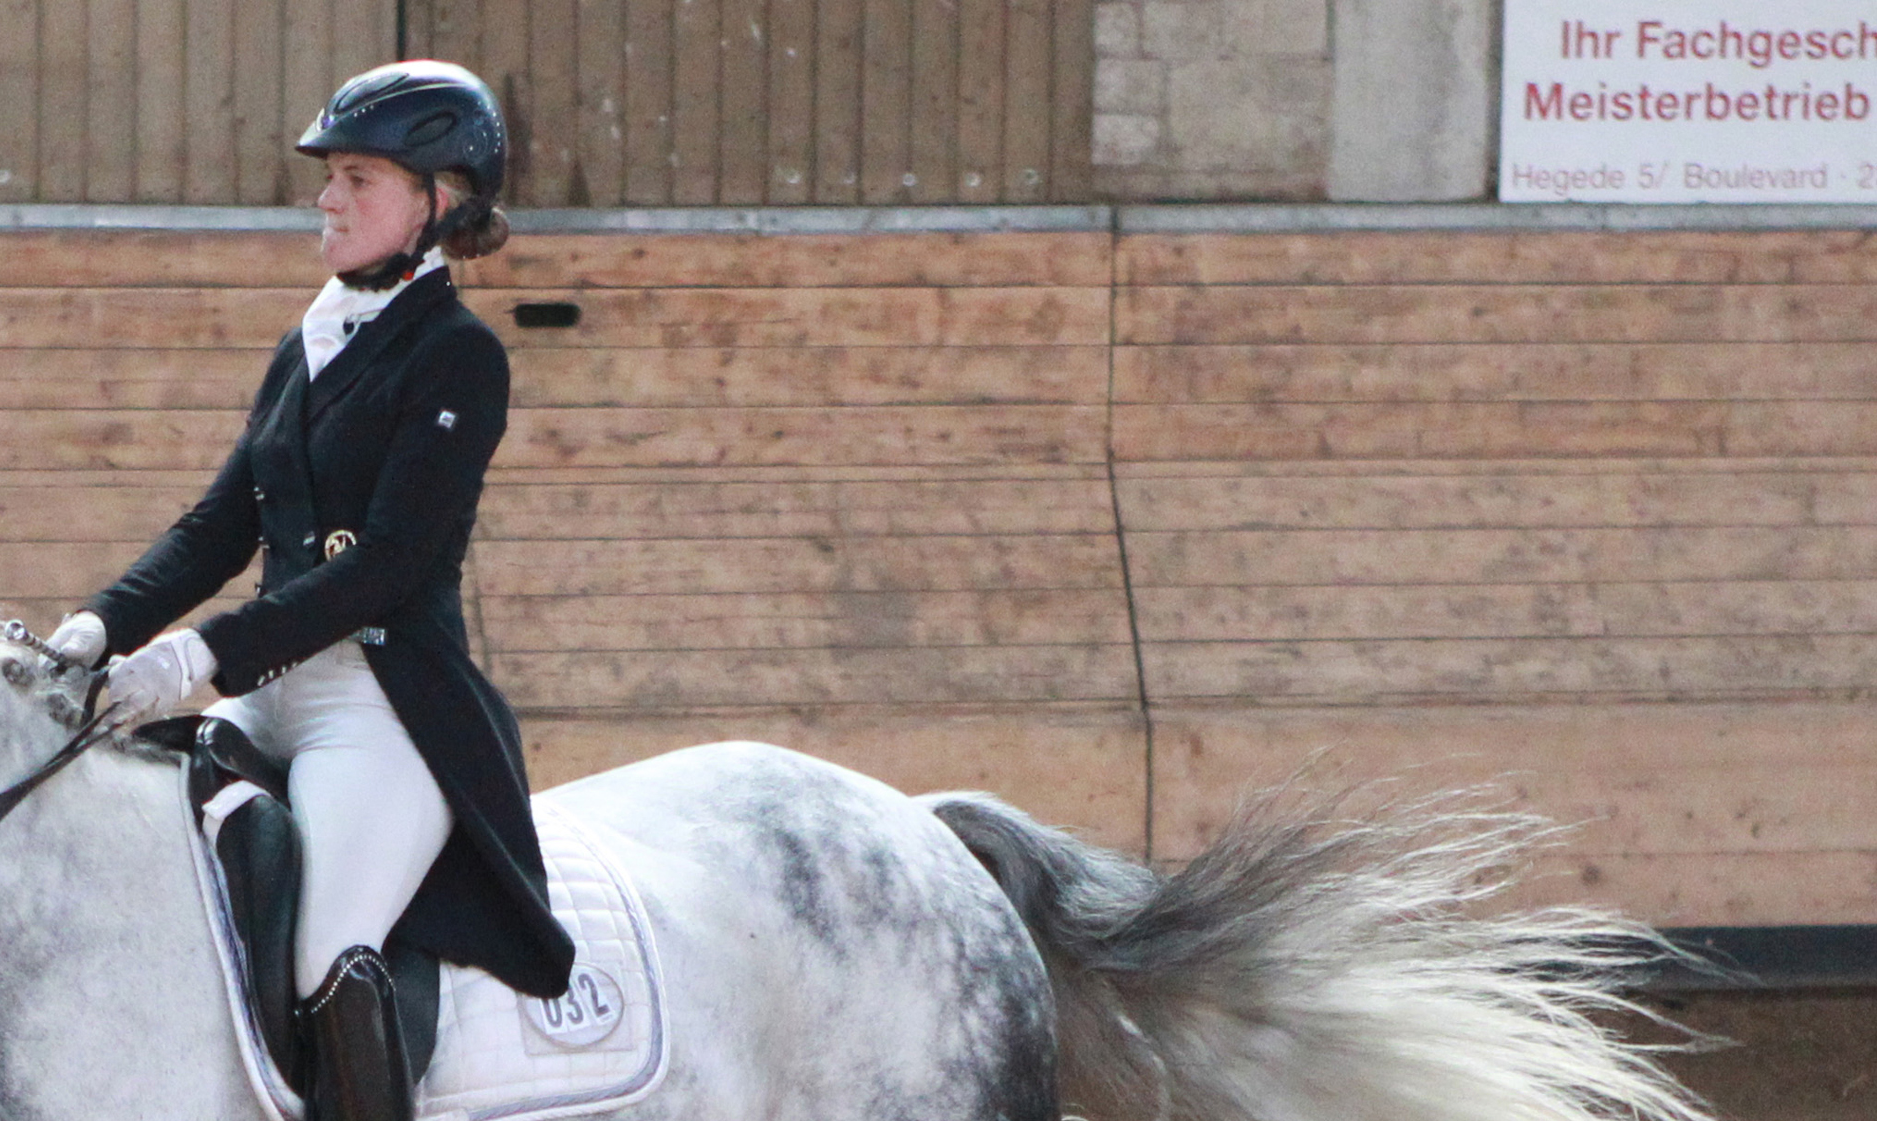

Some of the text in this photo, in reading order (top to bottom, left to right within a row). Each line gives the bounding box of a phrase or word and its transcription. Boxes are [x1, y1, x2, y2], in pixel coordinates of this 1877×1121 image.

[1561, 21, 1621, 59] Ihr
[1523, 81, 1870, 121] Meisterbetrieb
[1512, 162, 1625, 196] Hegede
[1684, 162, 1827, 190] Boulevard
[545, 972, 610, 1028] 032
